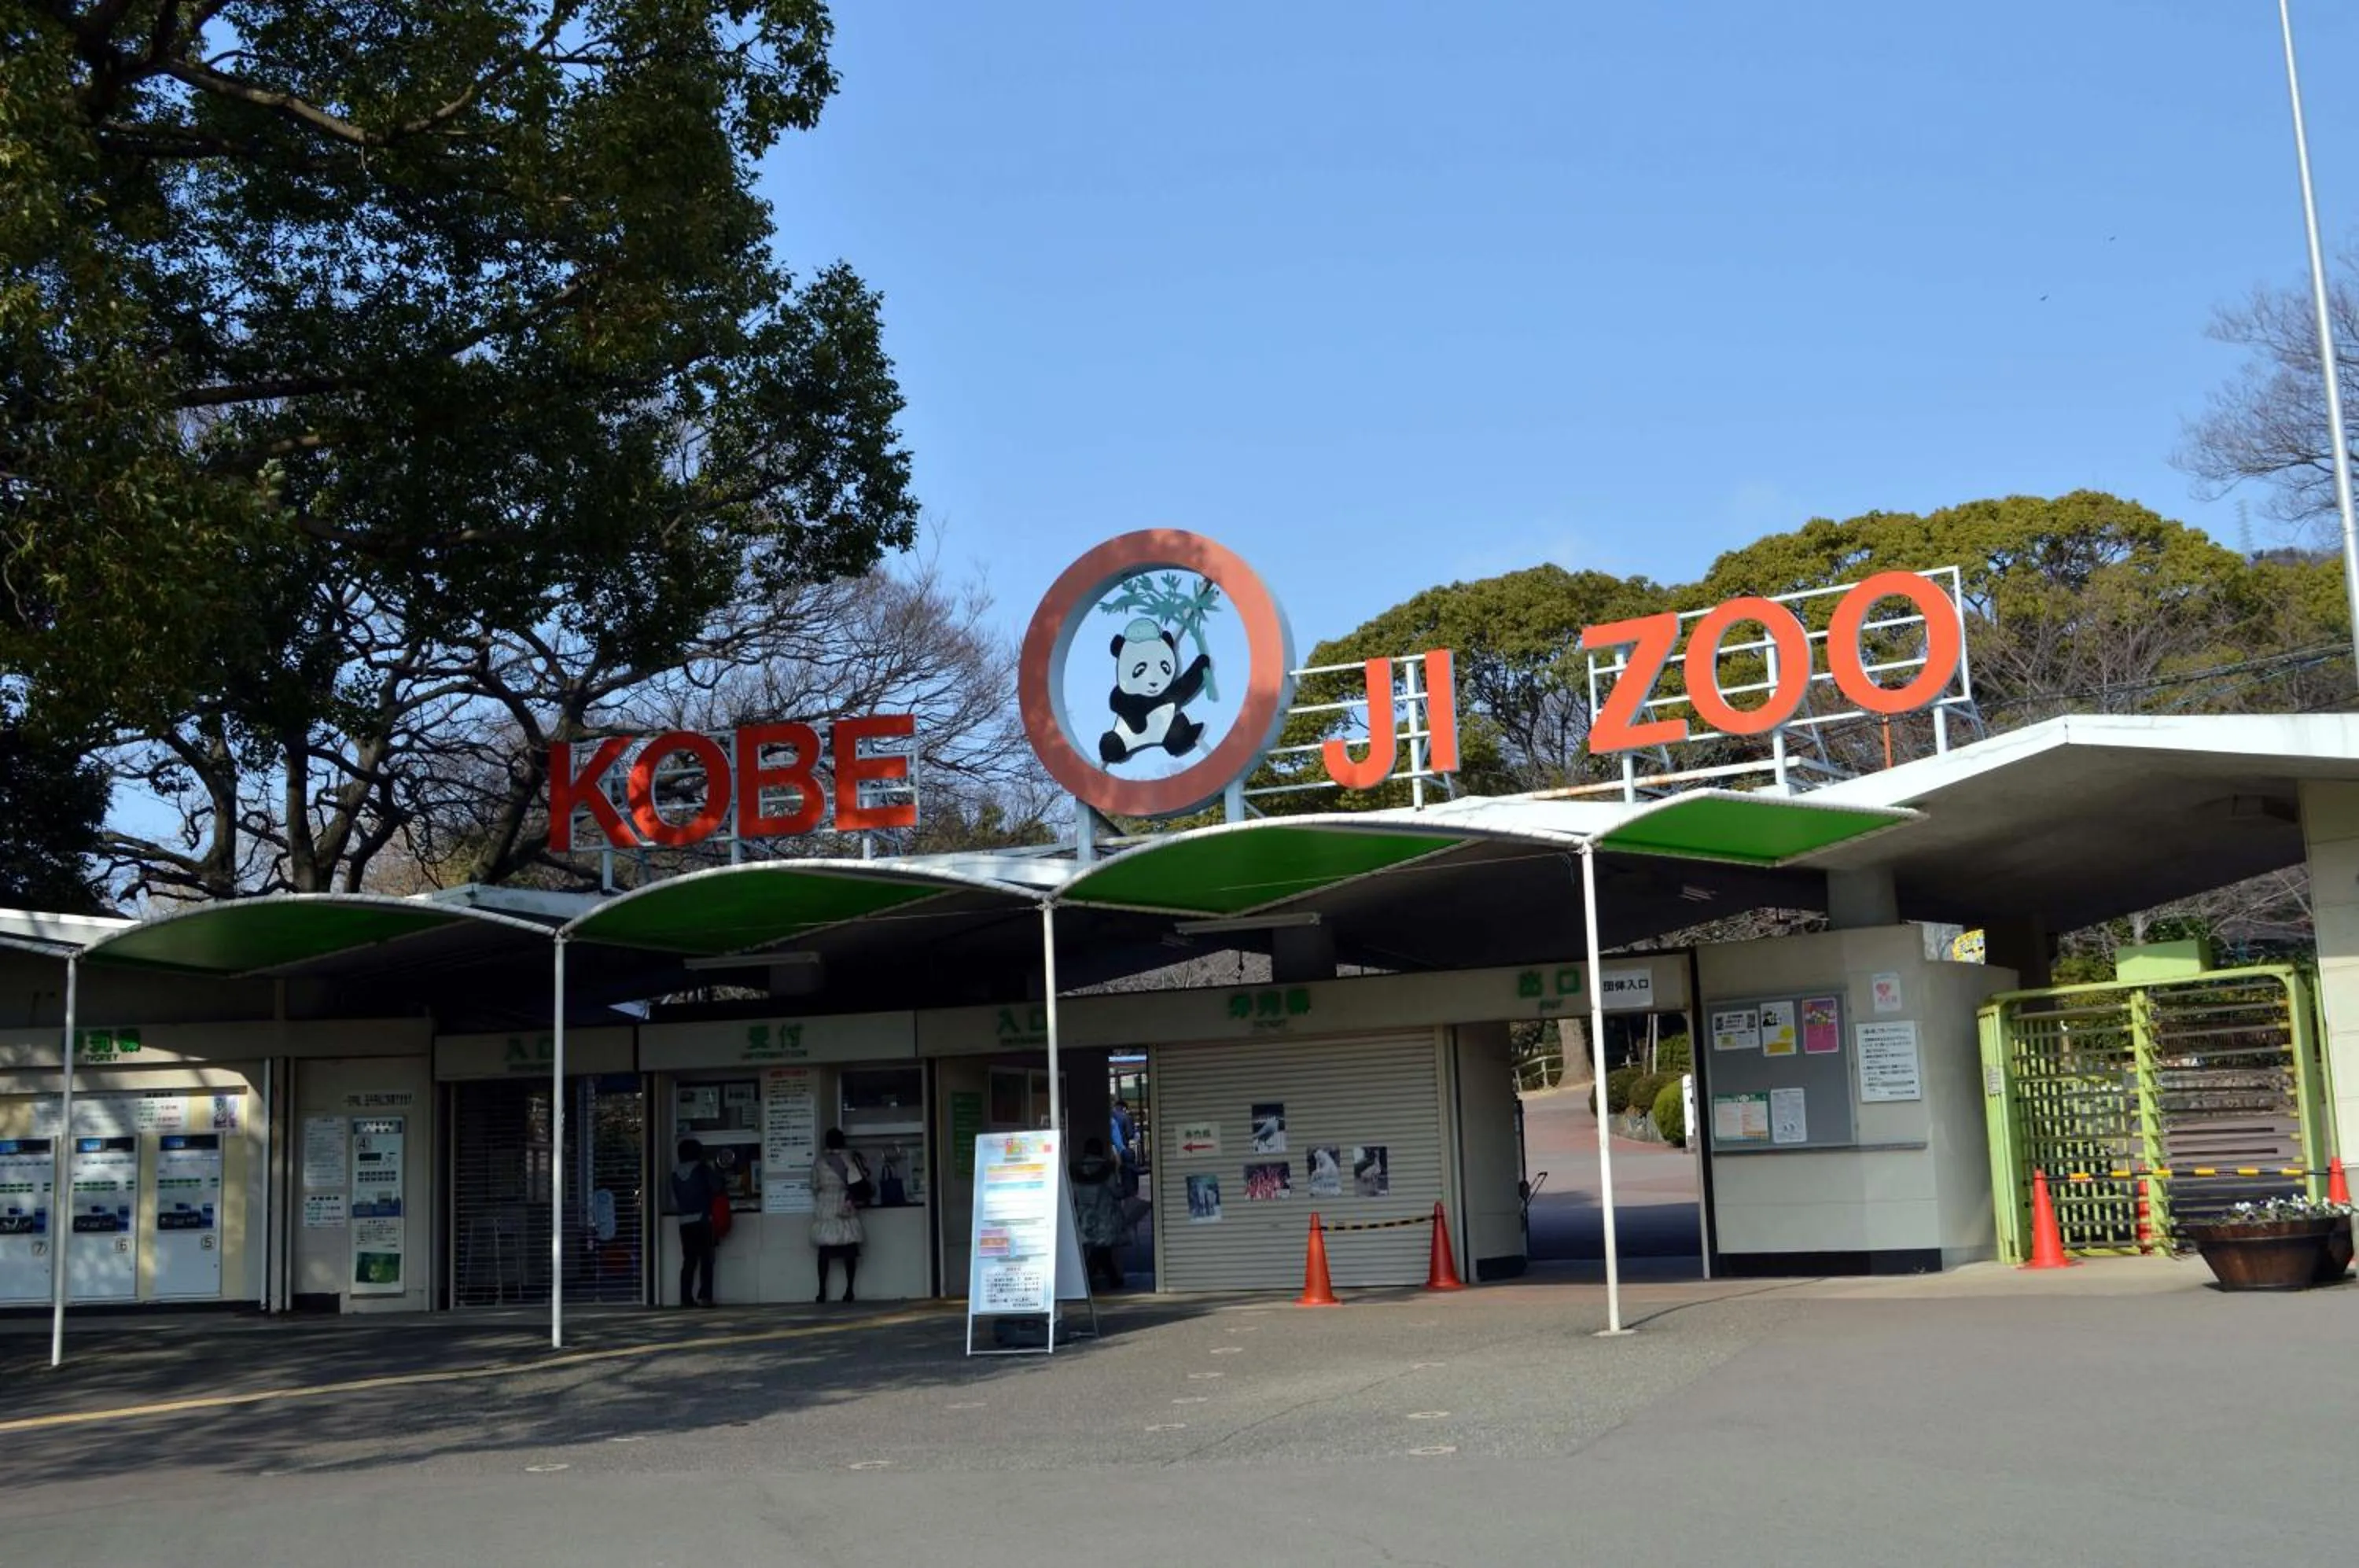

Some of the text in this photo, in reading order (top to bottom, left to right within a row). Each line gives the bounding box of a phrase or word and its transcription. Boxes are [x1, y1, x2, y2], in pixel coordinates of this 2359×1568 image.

[550, 713, 919, 852] KOBE
[1581, 569, 1963, 755] ZOO
[1518, 968, 1581, 997] 出口
[1603, 979, 1649, 992] 団体入口
[745, 1023, 804, 1049] 受付
